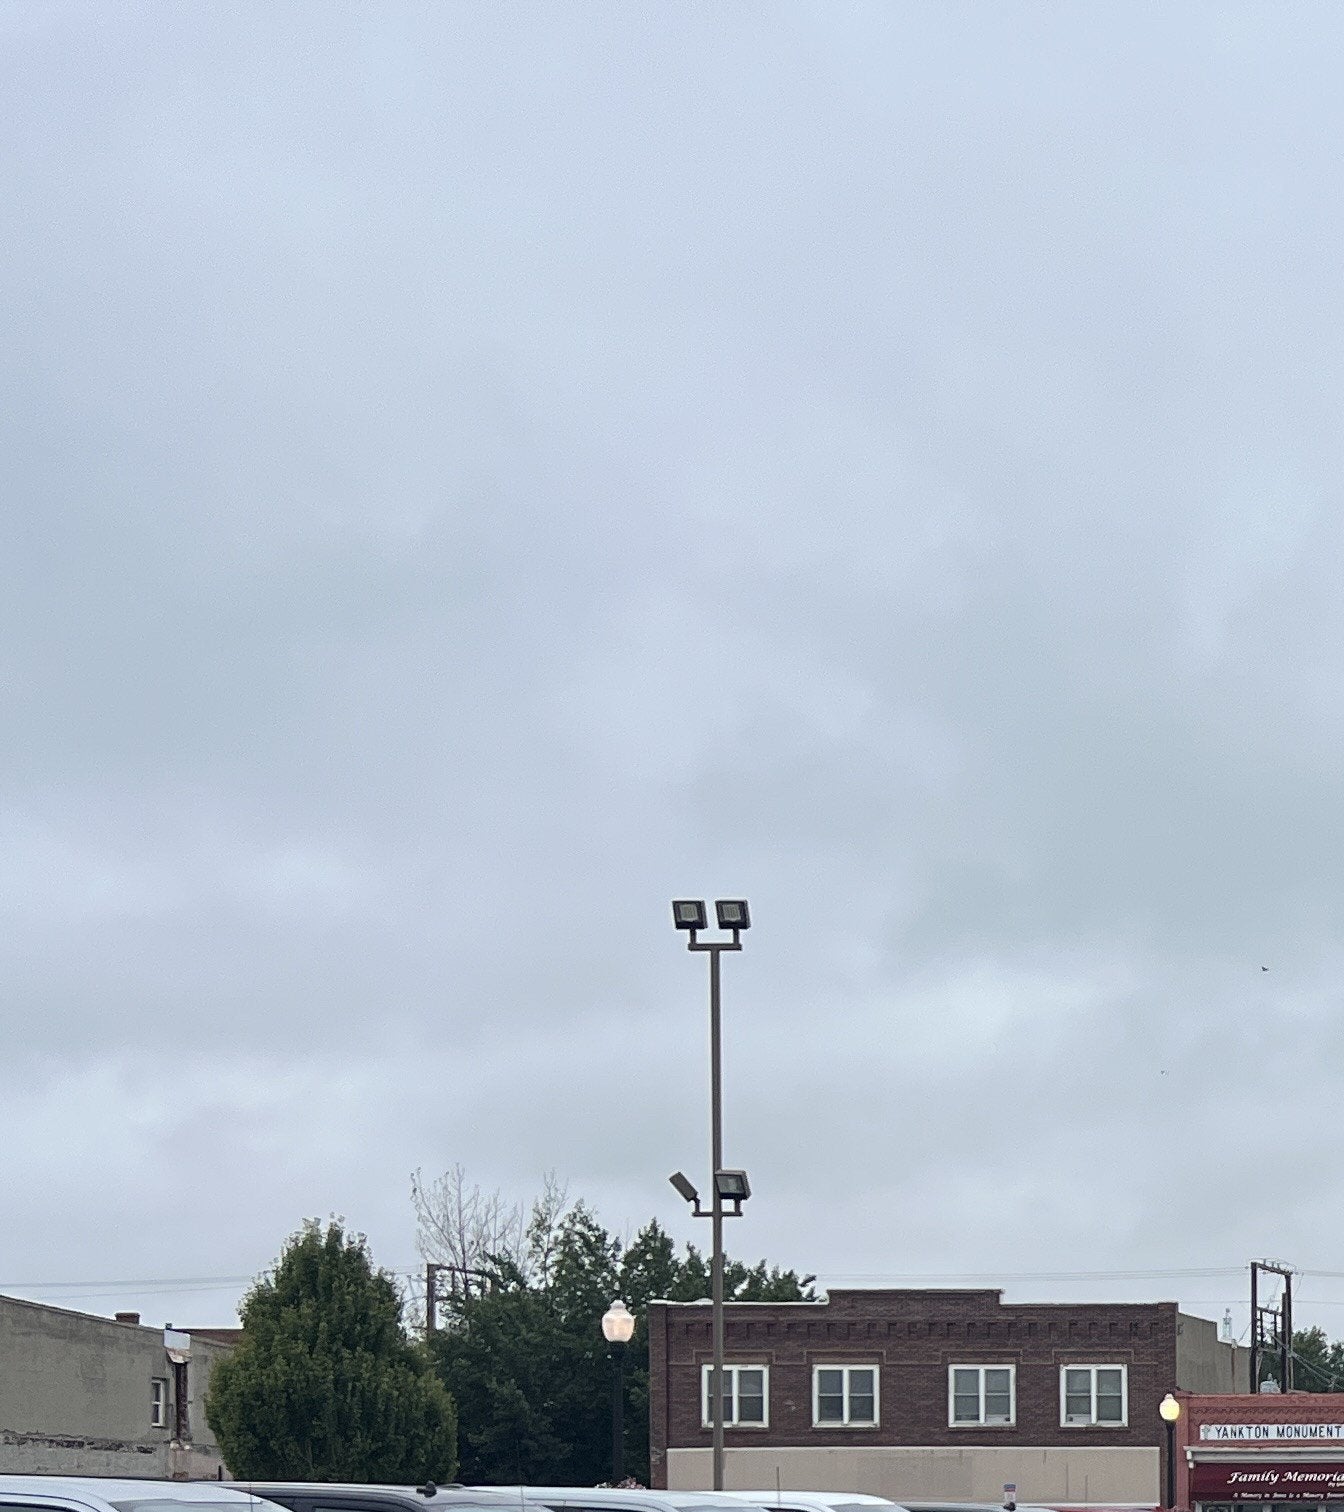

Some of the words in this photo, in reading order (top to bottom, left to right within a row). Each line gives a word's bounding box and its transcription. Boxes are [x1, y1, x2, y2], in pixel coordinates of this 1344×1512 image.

[1215, 1425, 1269, 1439] YANKTON
[1276, 1425, 1342, 1438] MONUMENT
[1227, 1469, 1280, 1486] Family
